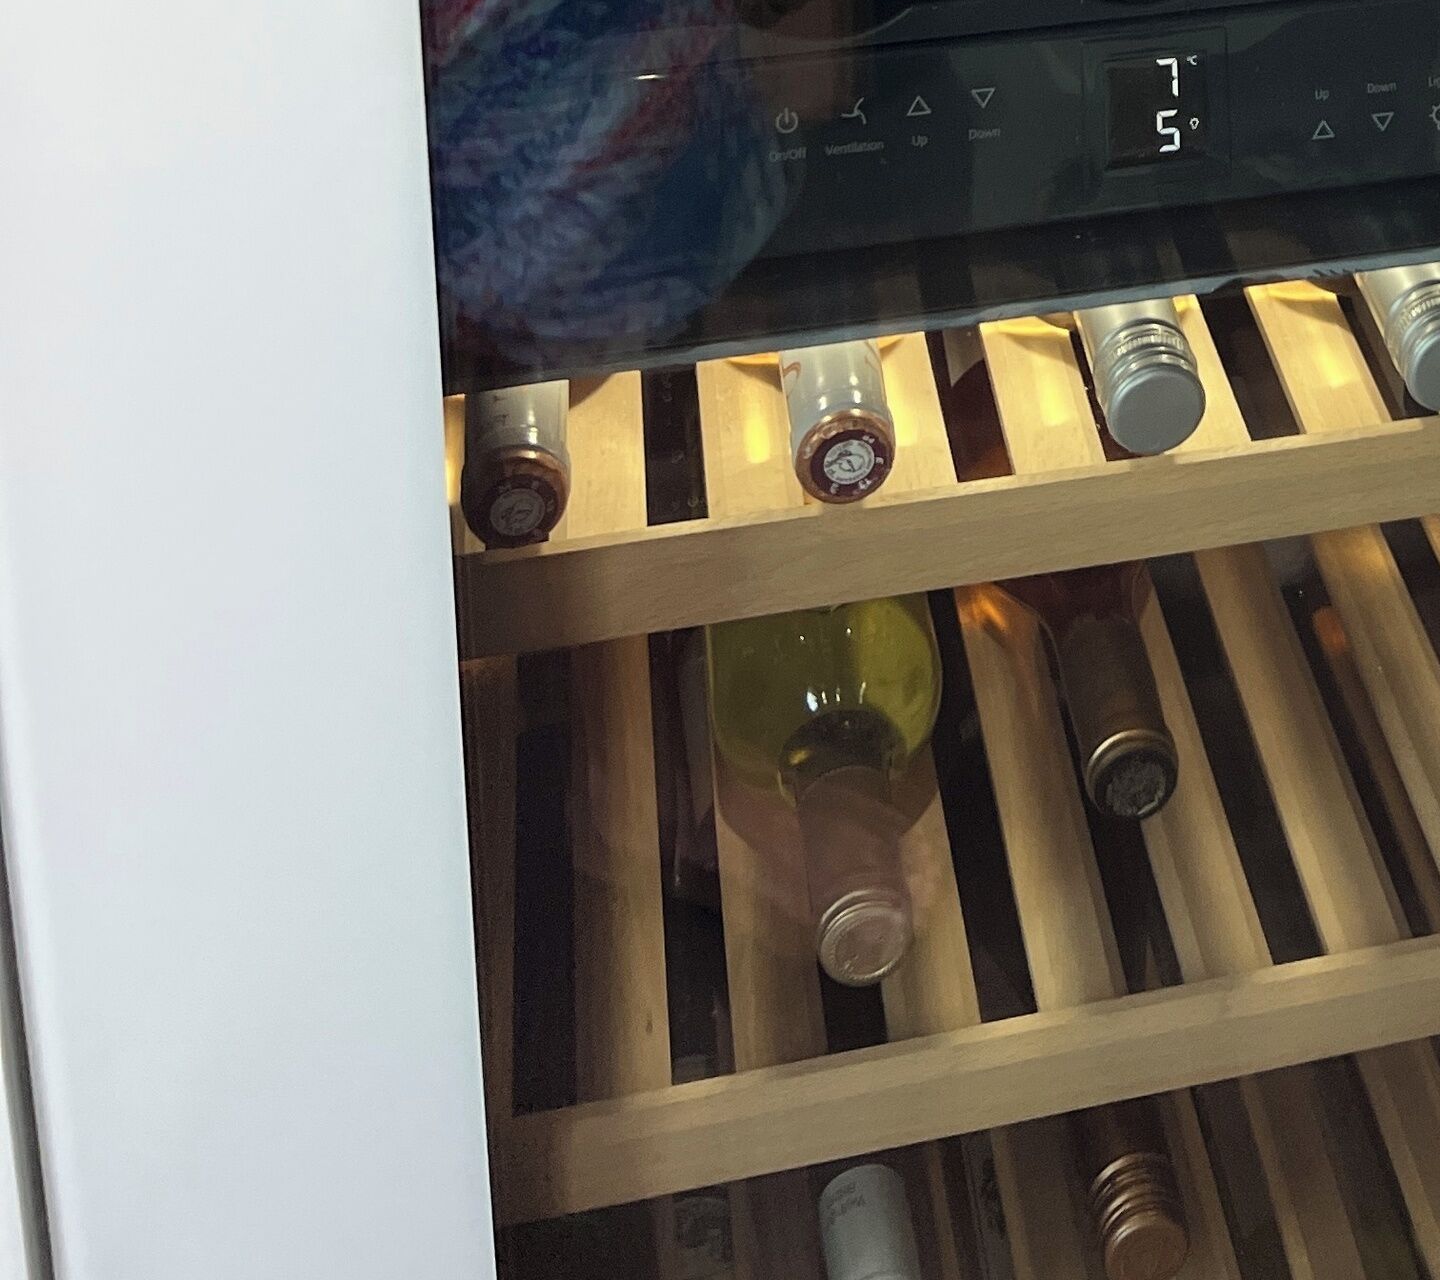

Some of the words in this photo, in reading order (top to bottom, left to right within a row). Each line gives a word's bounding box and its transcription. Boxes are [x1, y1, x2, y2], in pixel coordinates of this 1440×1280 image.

[1155, 56, 1179, 98] 7
[1314, 89, 1330, 101] Up
[1366, 81, 1397, 94] Down
[968, 127, 1001, 141] Down
[1155, 108, 1181, 153] 5
[825, 140, 885, 157] Ventilation
[911, 135, 928, 148] Up
[768, 146, 807, 162] On/Off
